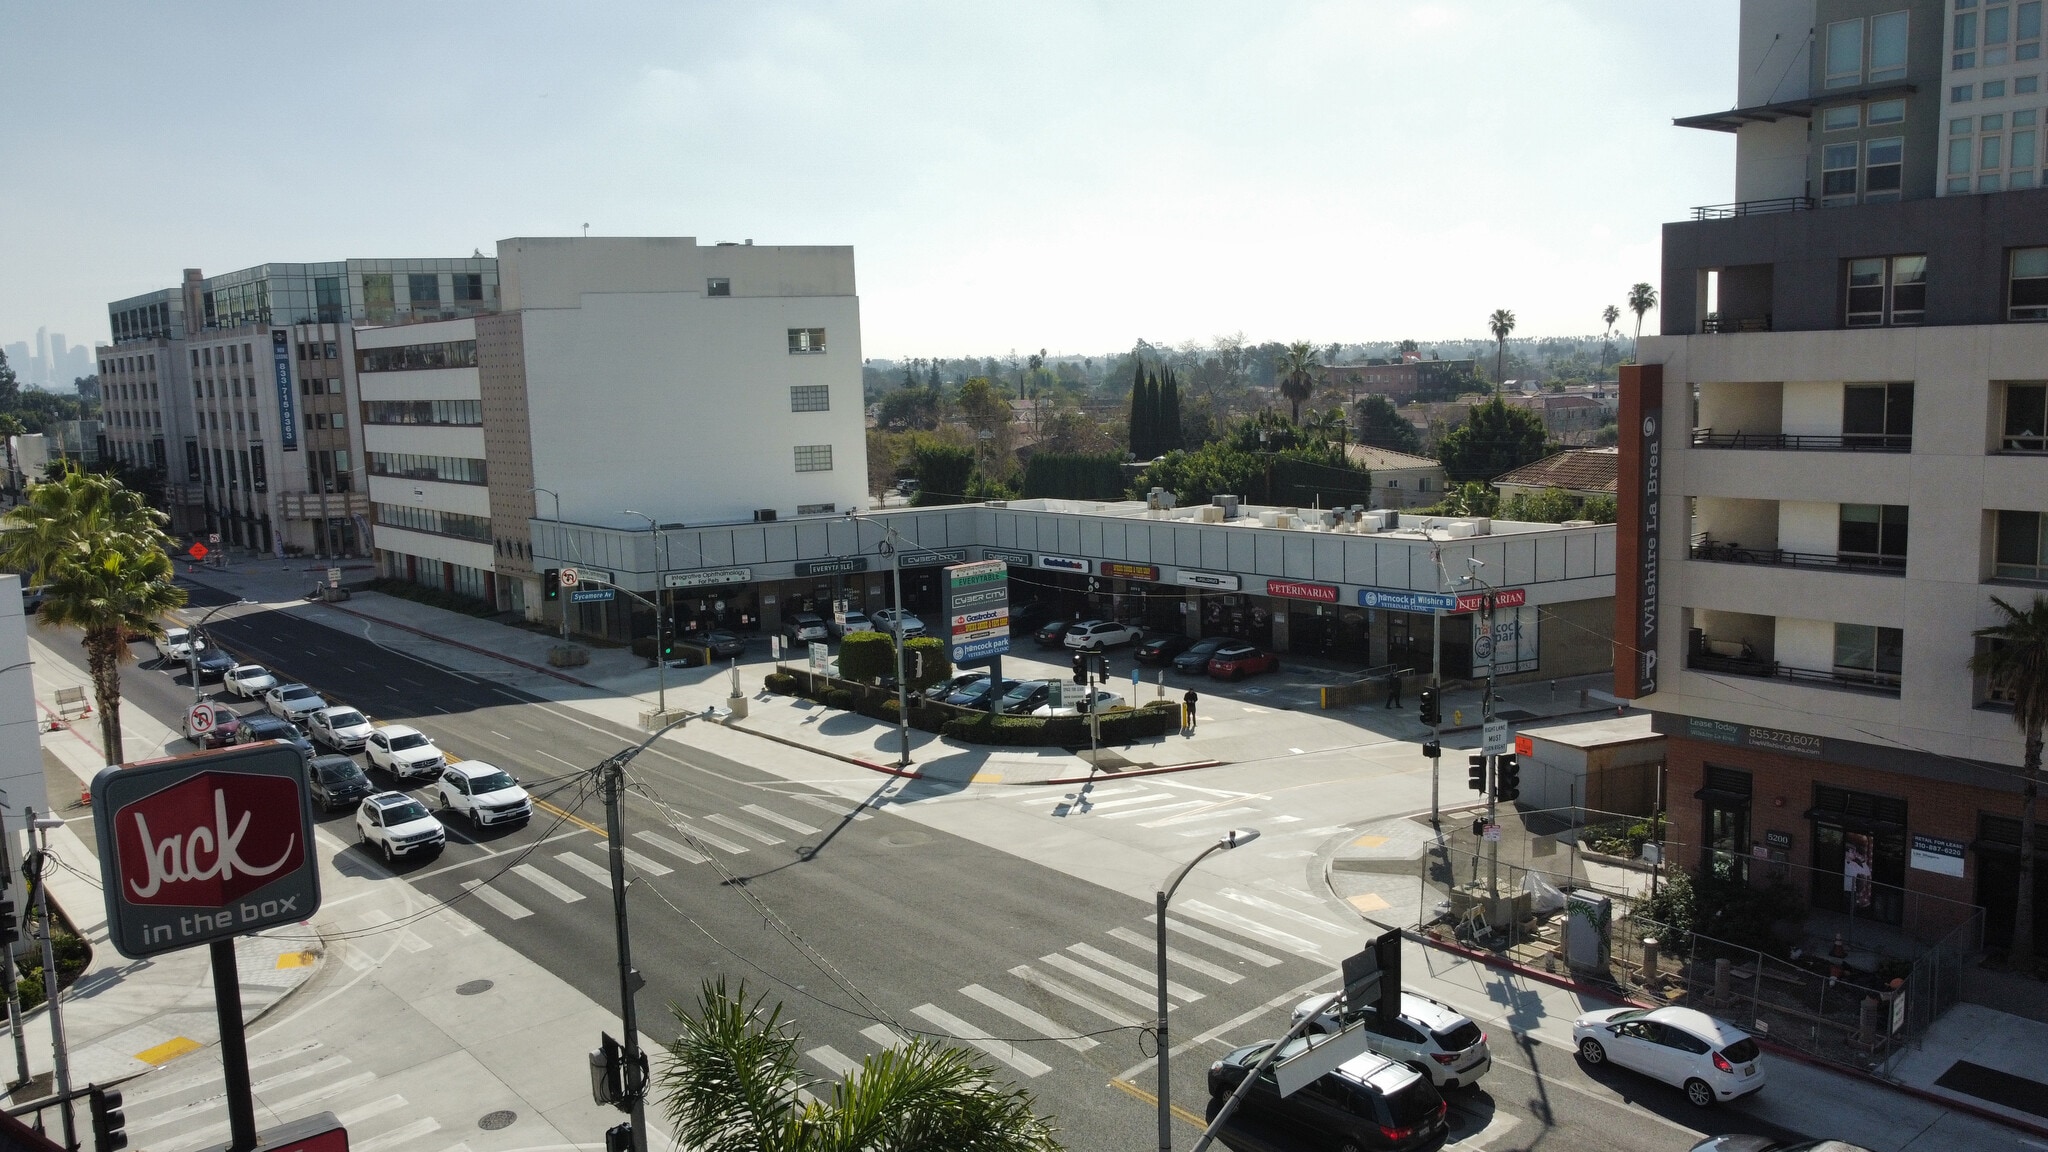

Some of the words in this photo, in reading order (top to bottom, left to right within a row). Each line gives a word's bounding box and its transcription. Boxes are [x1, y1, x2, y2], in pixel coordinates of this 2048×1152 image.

[1647, 441, 1658, 495] Brea
[1646, 502, 1657, 532] La
[671, 573, 701, 581] Integrative
[702, 569, 745, 578] Ophthalmology
[959, 573, 1000, 586] EVERYTABLE
[1269, 583, 1335, 599] VETERINARIAN
[1645, 536, 1656, 638] Wilshire
[574, 592, 603, 601] Sycamore
[954, 593, 985, 605] CYBER
[985, 590, 1005, 599] CITY
[1417, 596, 1444, 606] Wilshire
[966, 611, 998, 623] Gastrobot
[993, 637, 1009, 650] park
[1646, 649, 1657, 679] P
[1689, 718, 1713, 729] Lease
[1714, 721, 1738, 734] Today
[1488, 734, 1502, 742] MUST
[1748, 728, 1820, 748] 855.273.6074
[129, 788, 295, 898] Jack
[1767, 833, 1788, 844] 5200
[1914, 835, 1933, 844] RETAIL
[143, 923, 173, 945] in
[180, 909, 233, 936] the
[240, 895, 298, 923] box
